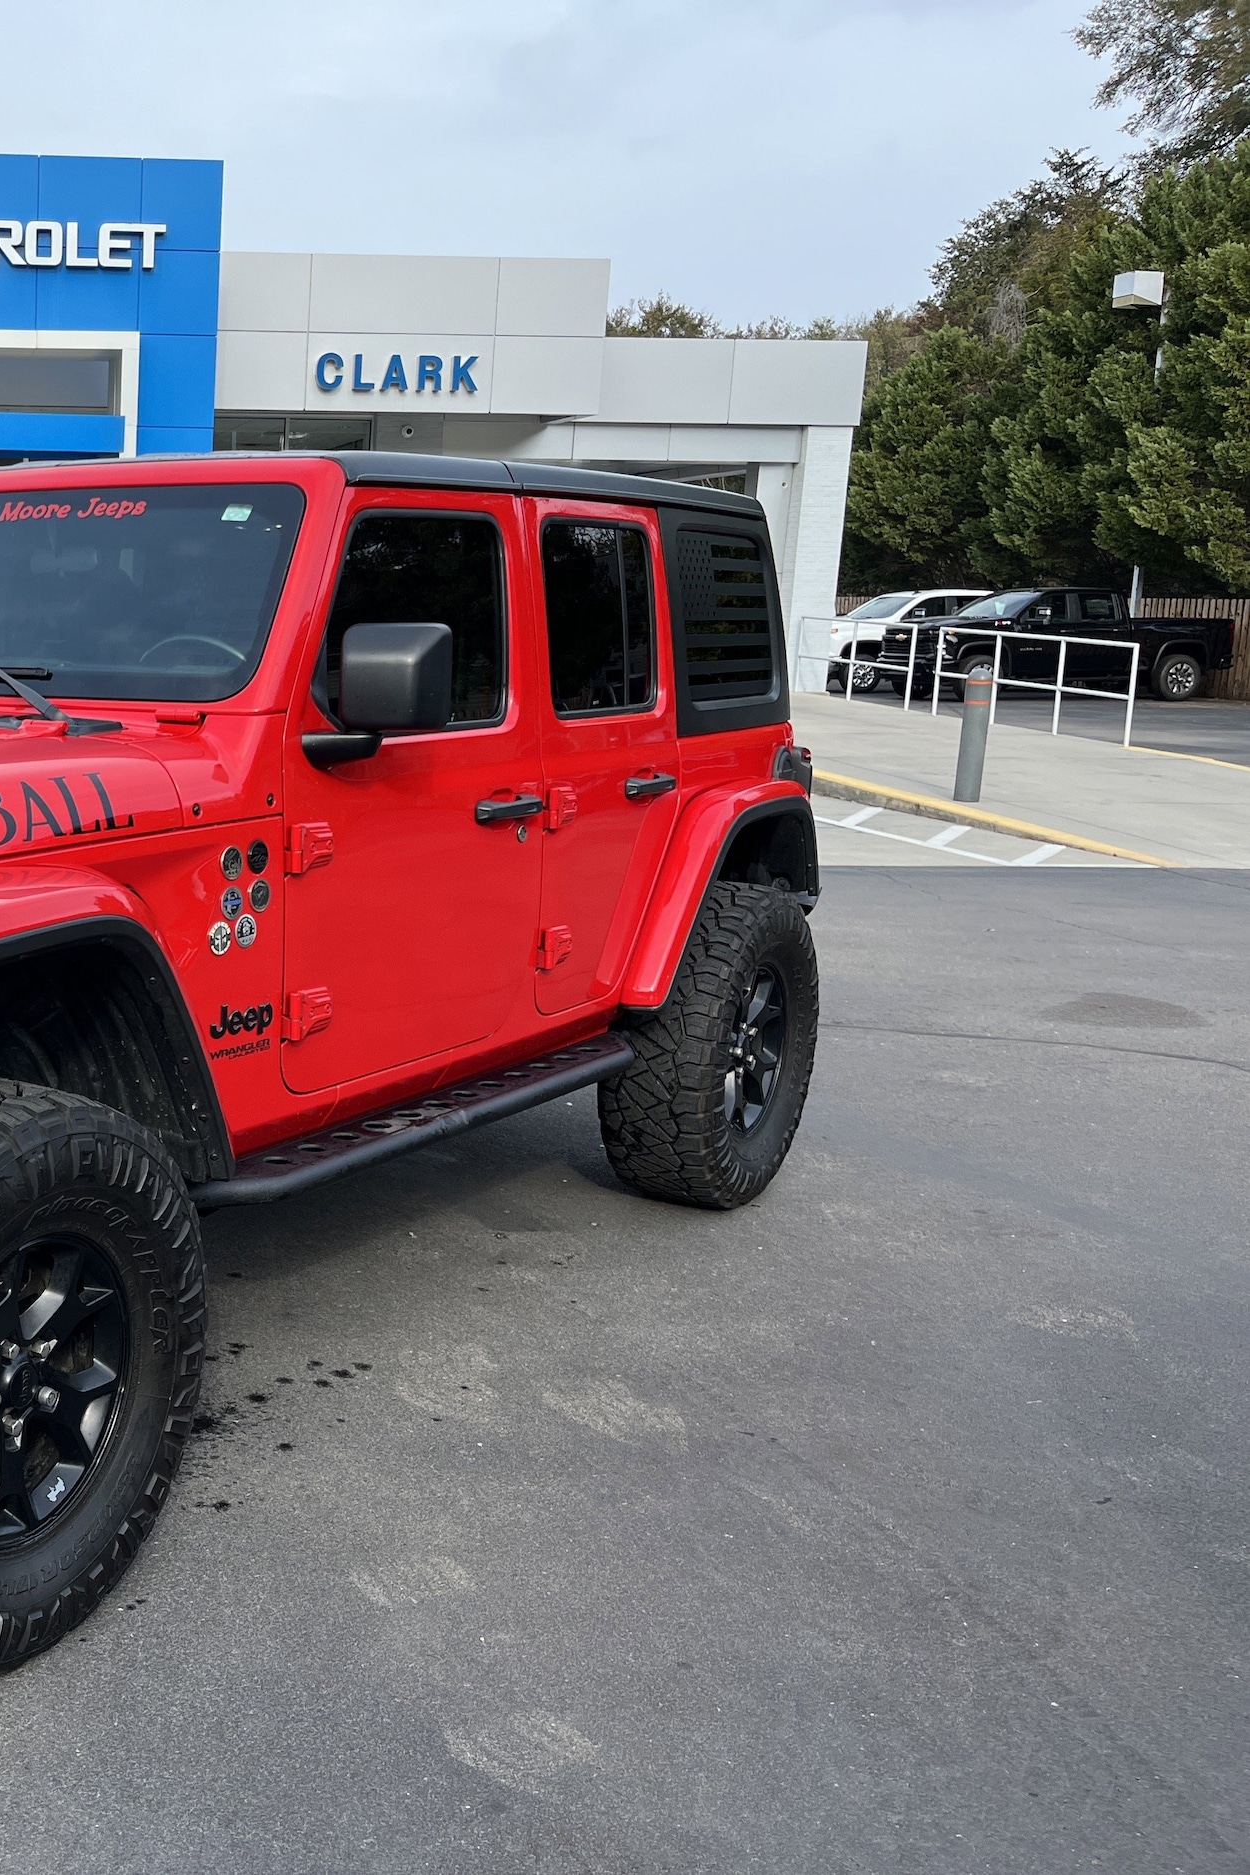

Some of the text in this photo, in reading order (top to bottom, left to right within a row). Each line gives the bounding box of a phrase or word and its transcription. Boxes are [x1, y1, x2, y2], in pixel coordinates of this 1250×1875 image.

[315, 352, 479, 393] CLARK
[77, 497, 147, 519] Jeeps
[210, 1003, 273, 1039] Jeep
[210, 1038, 270, 1061] WRANGLER
